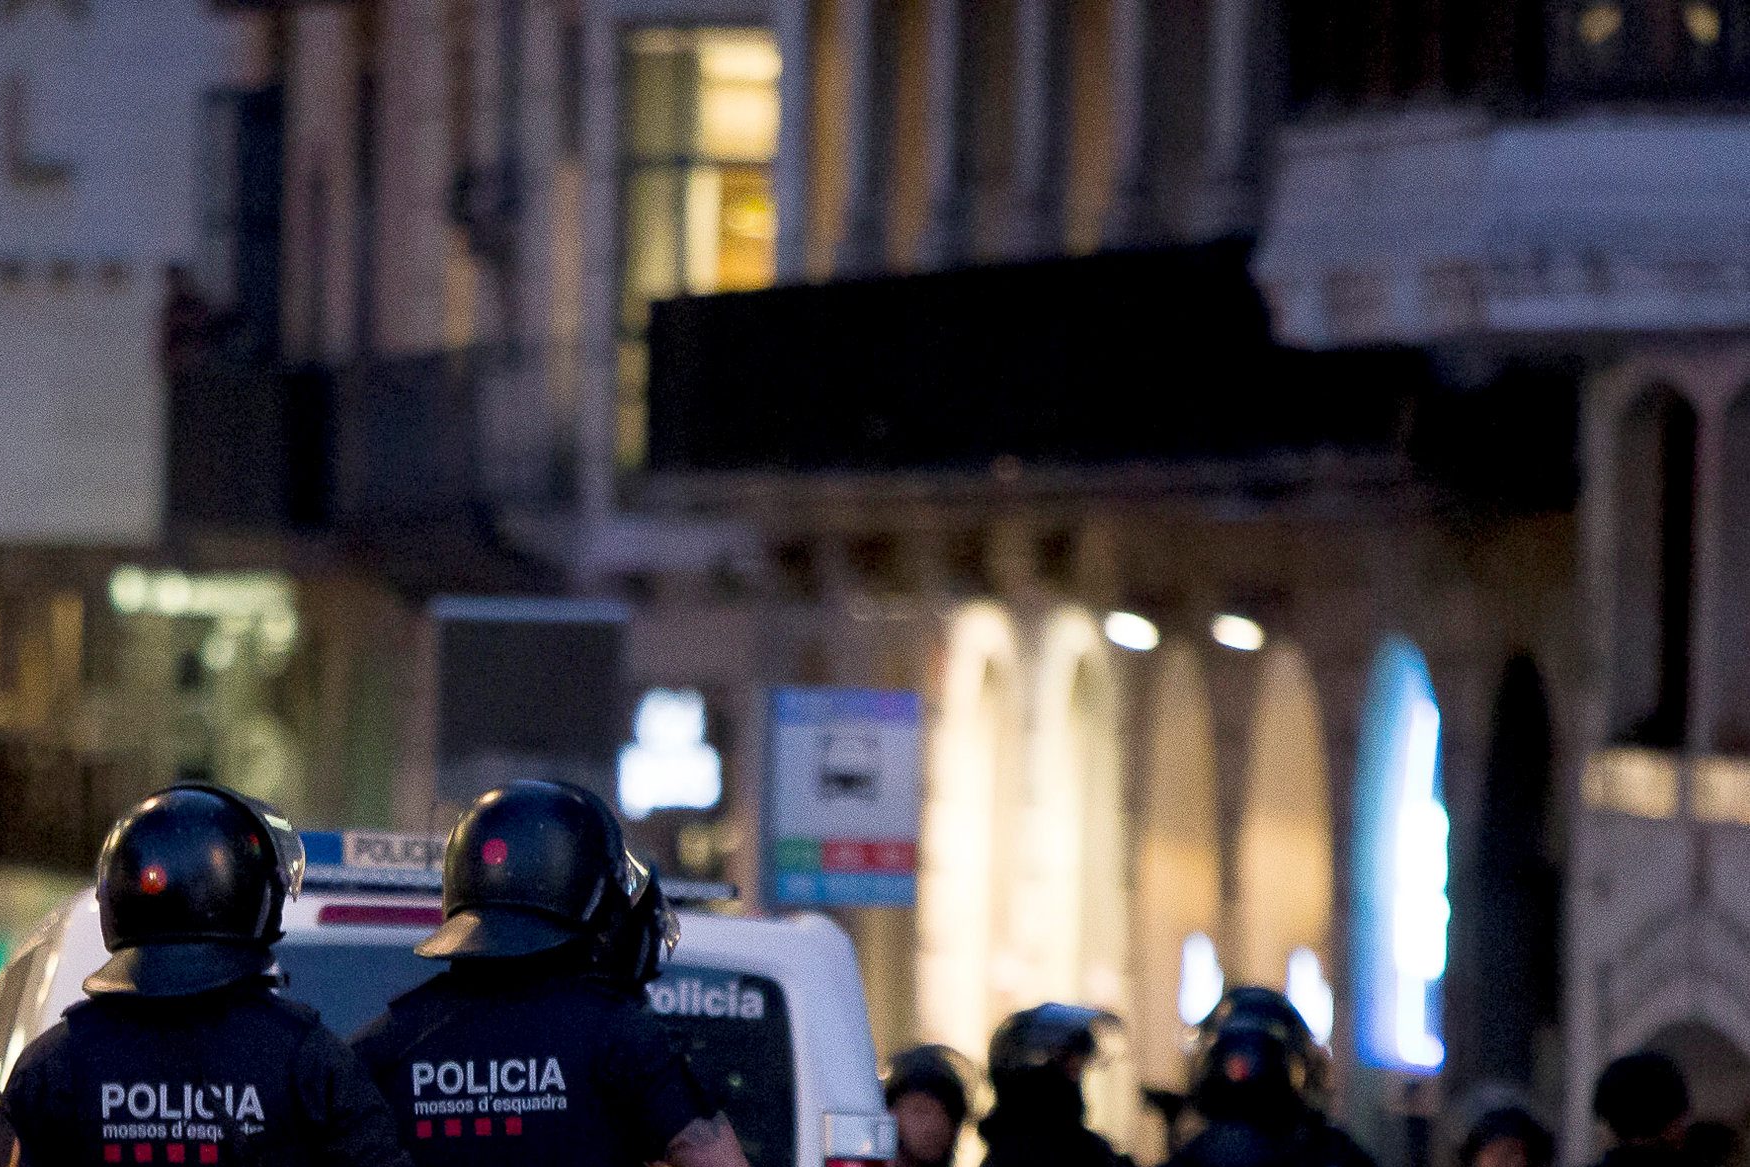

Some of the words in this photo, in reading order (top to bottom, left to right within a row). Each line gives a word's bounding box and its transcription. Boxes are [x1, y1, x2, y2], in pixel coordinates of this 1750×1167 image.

[646, 979, 764, 1018] olicia
[412, 1057, 567, 1096] POLICIA
[101, 1083, 266, 1121] POLICIA
[414, 1098, 474, 1115] mossos
[478, 1094, 567, 1115] d'esquadra
[103, 1122, 168, 1139] mossos
